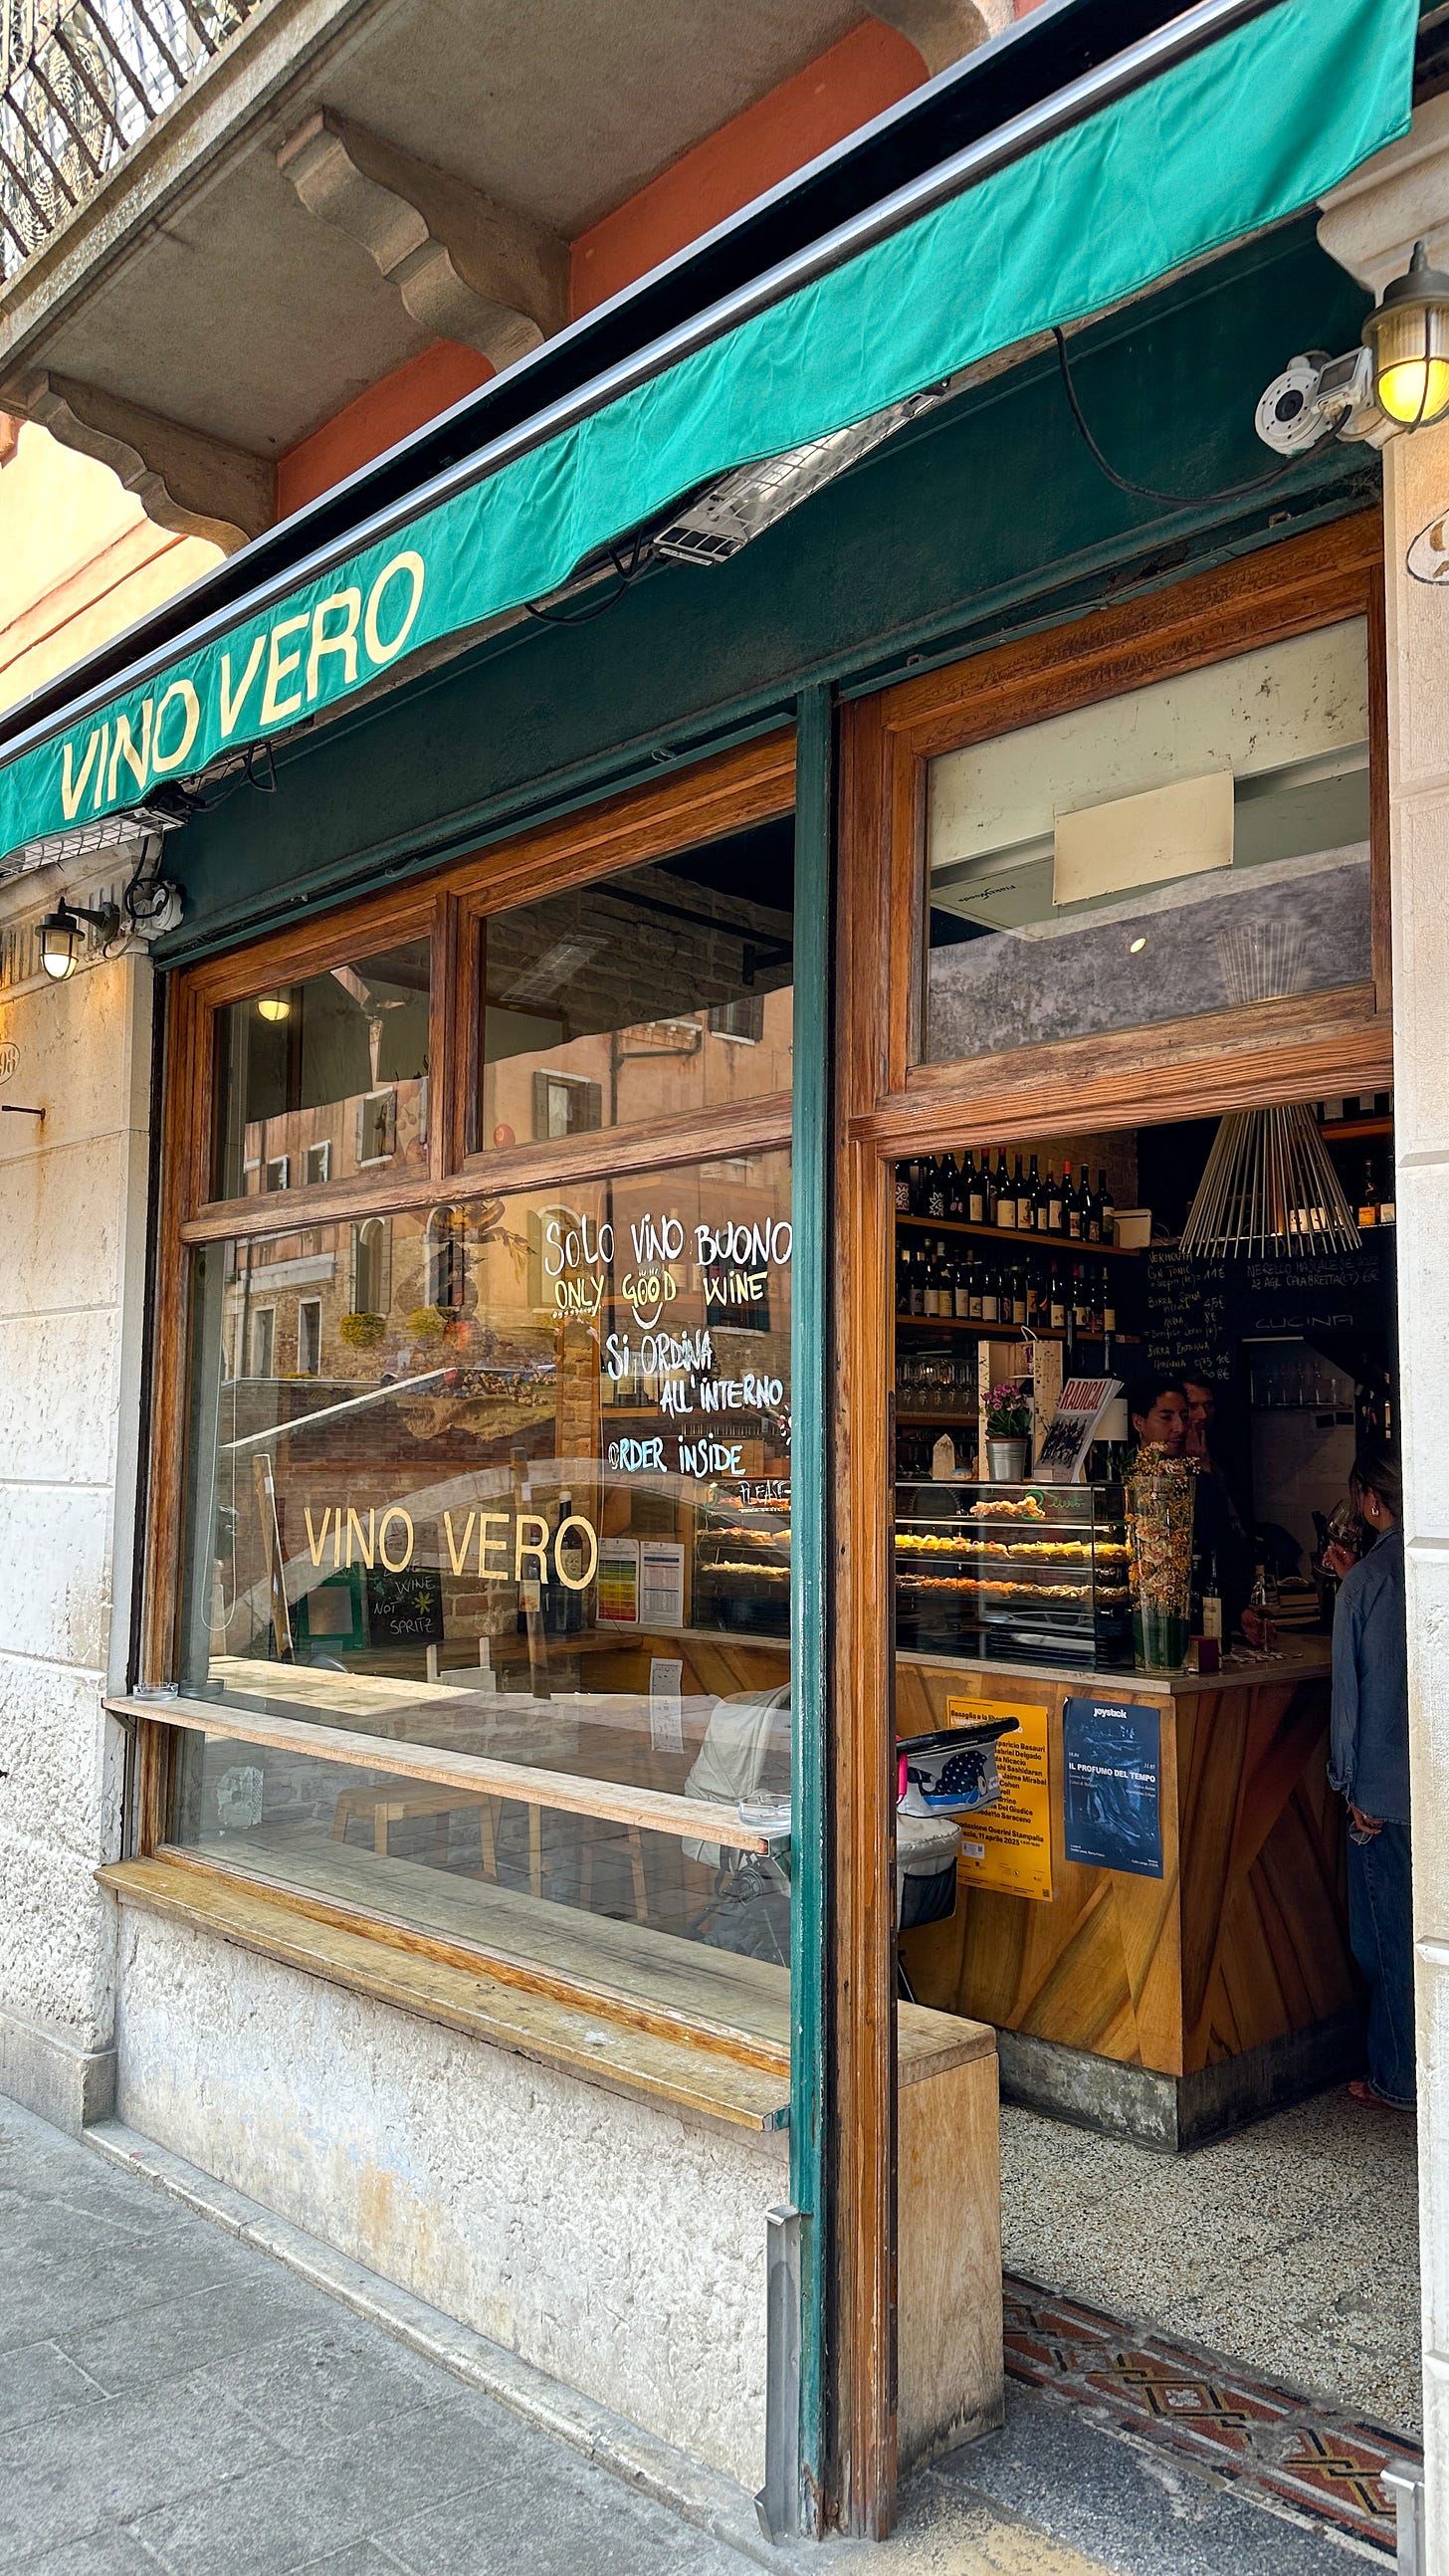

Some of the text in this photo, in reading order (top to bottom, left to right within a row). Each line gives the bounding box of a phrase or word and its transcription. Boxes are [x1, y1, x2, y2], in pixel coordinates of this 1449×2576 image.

[62, 550, 425, 820] VINO VERO
[694, 1216, 793, 1267] BUONO
[554, 1274, 605, 1316] ONLY
[1255, 1314, 1353, 1329] CUCINA
[1059, 1381, 1108, 1410] RADICAL
[608, 1436, 668, 1473] ORDER
[304, 1506, 415, 1574] VINO
[443, 1511, 598, 1591] VERO
[394, 1576, 436, 1595] WINE
[373, 1600, 402, 1615] NOT
[389, 1616, 435, 1635] SPRITZ
[1094, 1707, 1128, 1720] joystick
[1077, 1763, 1113, 1776] PROFUMO
[1114, 1769, 1129, 1779] DEL
[1130, 1771, 1156, 1783] TEMPO
[987, 1825, 1011, 1836] Querini
[1003, 1836, 1020, 1846] 2025
